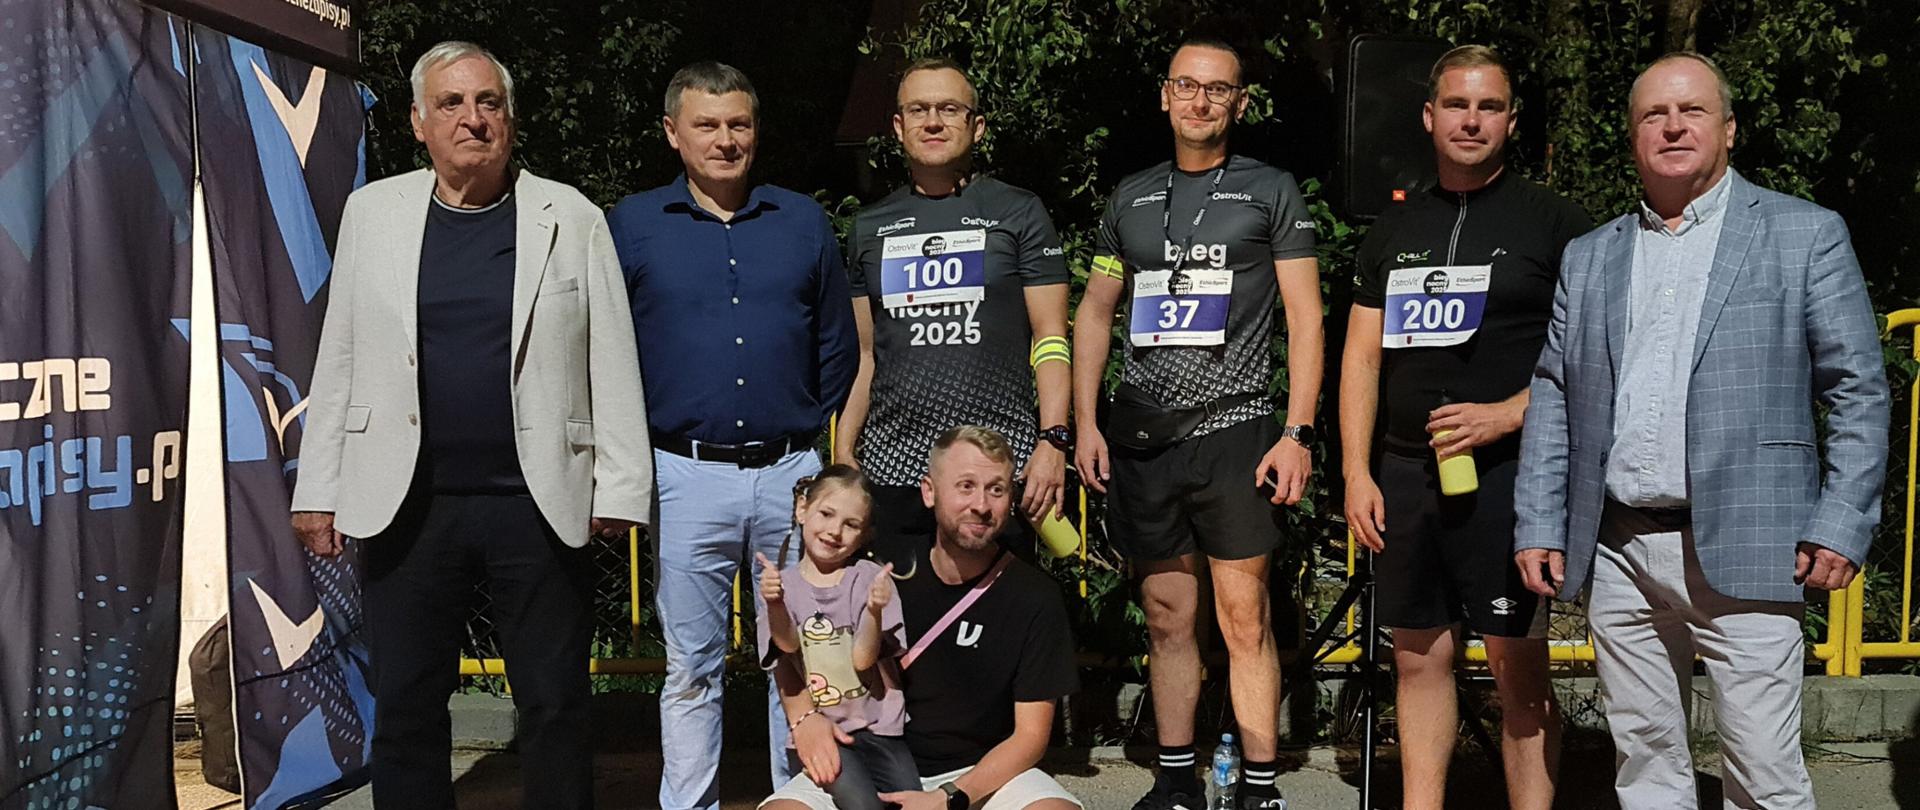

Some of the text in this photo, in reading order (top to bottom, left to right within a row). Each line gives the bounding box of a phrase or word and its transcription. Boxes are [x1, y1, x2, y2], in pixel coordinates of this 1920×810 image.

[285, 0, 351, 30] nezapisy.pl
[1212, 192, 1252, 202] OstroVit
[887, 243, 917, 253] OstroVit
[1164, 240, 1228, 268] beg
[903, 257, 963, 289] 100
[1137, 280, 1163, 290] OstroVit
[1391, 278, 1418, 288] OstroVit
[1158, 299, 1200, 329] 37
[1403, 298, 1465, 330] 200
[910, 321, 981, 346] 2025
